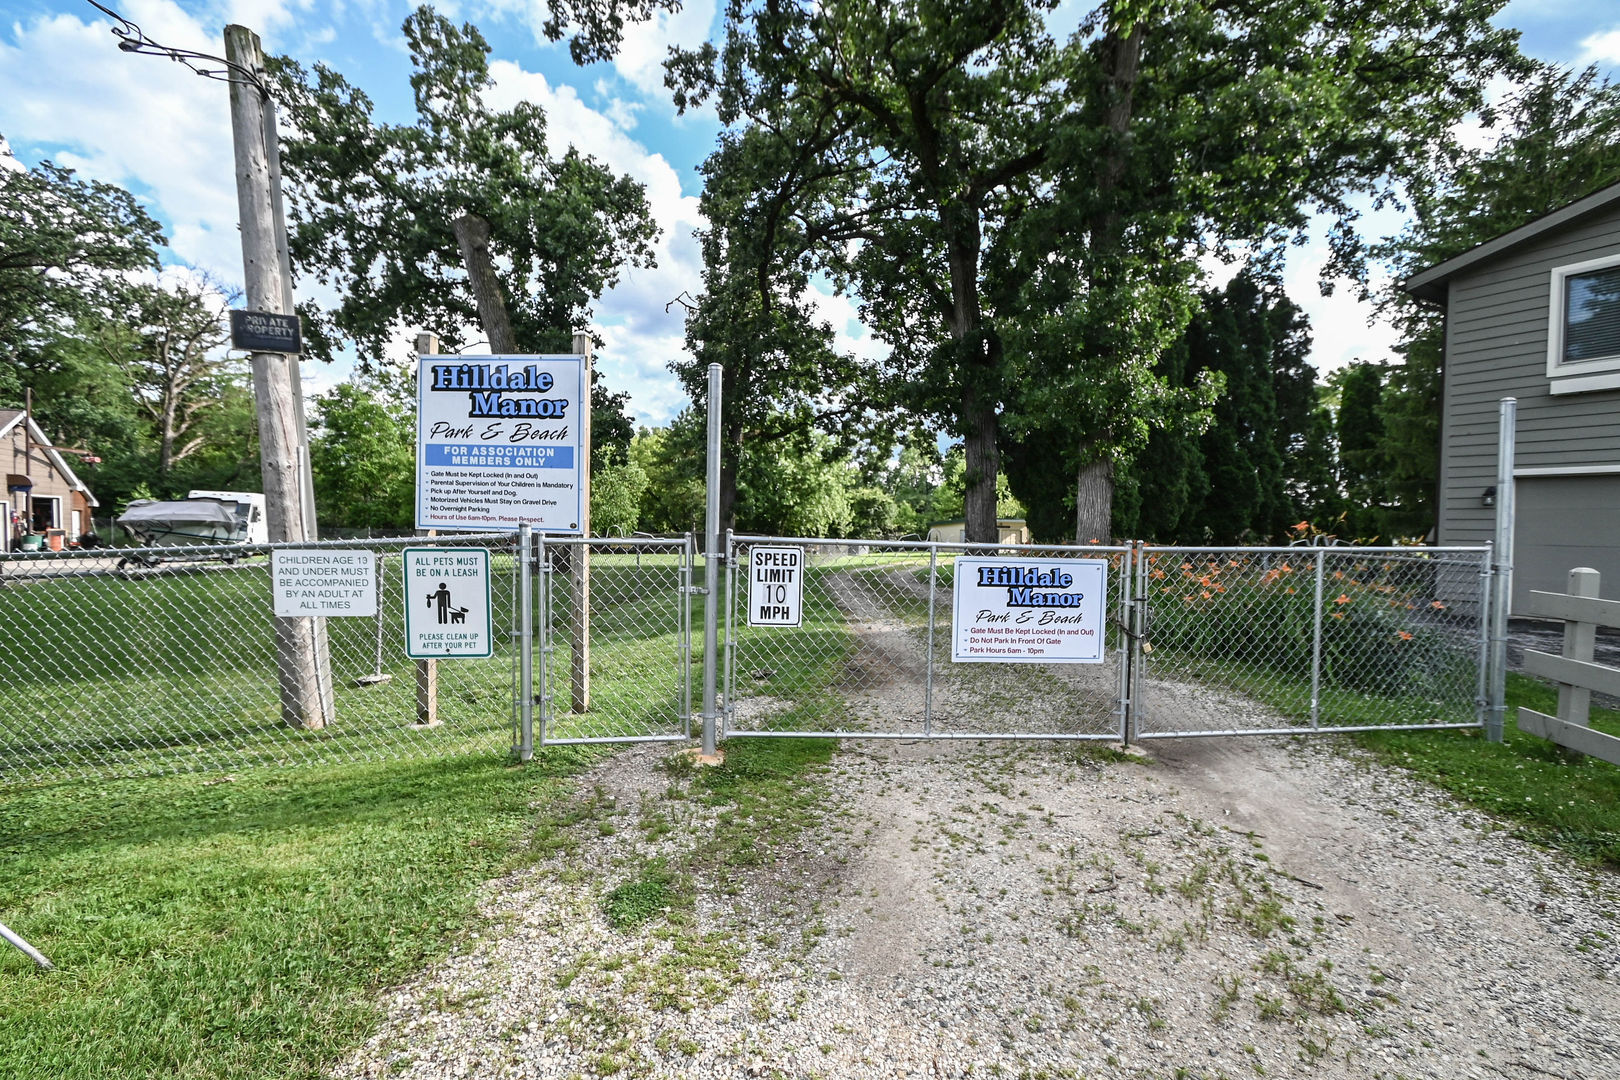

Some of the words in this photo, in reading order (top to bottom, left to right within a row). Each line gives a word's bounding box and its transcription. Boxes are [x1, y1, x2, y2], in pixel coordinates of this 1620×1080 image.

[240, 324, 294, 336] ROPERTY
[431, 364, 554, 393] Hilldale
[468, 392, 569, 419] Manor
[430, 422, 474, 440] Park
[480, 422, 504, 440] &
[508, 422, 568, 442] Beach
[444, 446, 468, 456] FOR
[472, 446, 554, 457] ASSOCIATION
[452, 456, 511, 466] MEMBERS
[515, 456, 546, 466] ONLY
[278, 556, 330, 564] CHILDREN
[332, 556, 354, 564] AGE
[416, 557, 430, 565] ALL
[434, 557, 454, 565] PETS
[456, 557, 478, 566] MUST
[755, 552, 798, 566] SPEED
[416, 568, 426, 576] BE
[430, 568, 441, 576] ON
[444, 568, 450, 576] A
[452, 568, 478, 576] LEASH
[756, 569, 794, 582] LIMIT
[977, 566, 1073, 589] Hilldale
[280, 579, 292, 587] BE
[295, 579, 369, 587] ACCOMPANIED
[766, 585, 786, 604] 10
[1006, 587, 1084, 608] Manor
[760, 606, 790, 620] MPH
[975, 609, 1011, 623] Park
[1015, 610, 1034, 624] &
[1038, 611, 1084, 626] Beach
[1015, 628, 1030, 636] Kept
